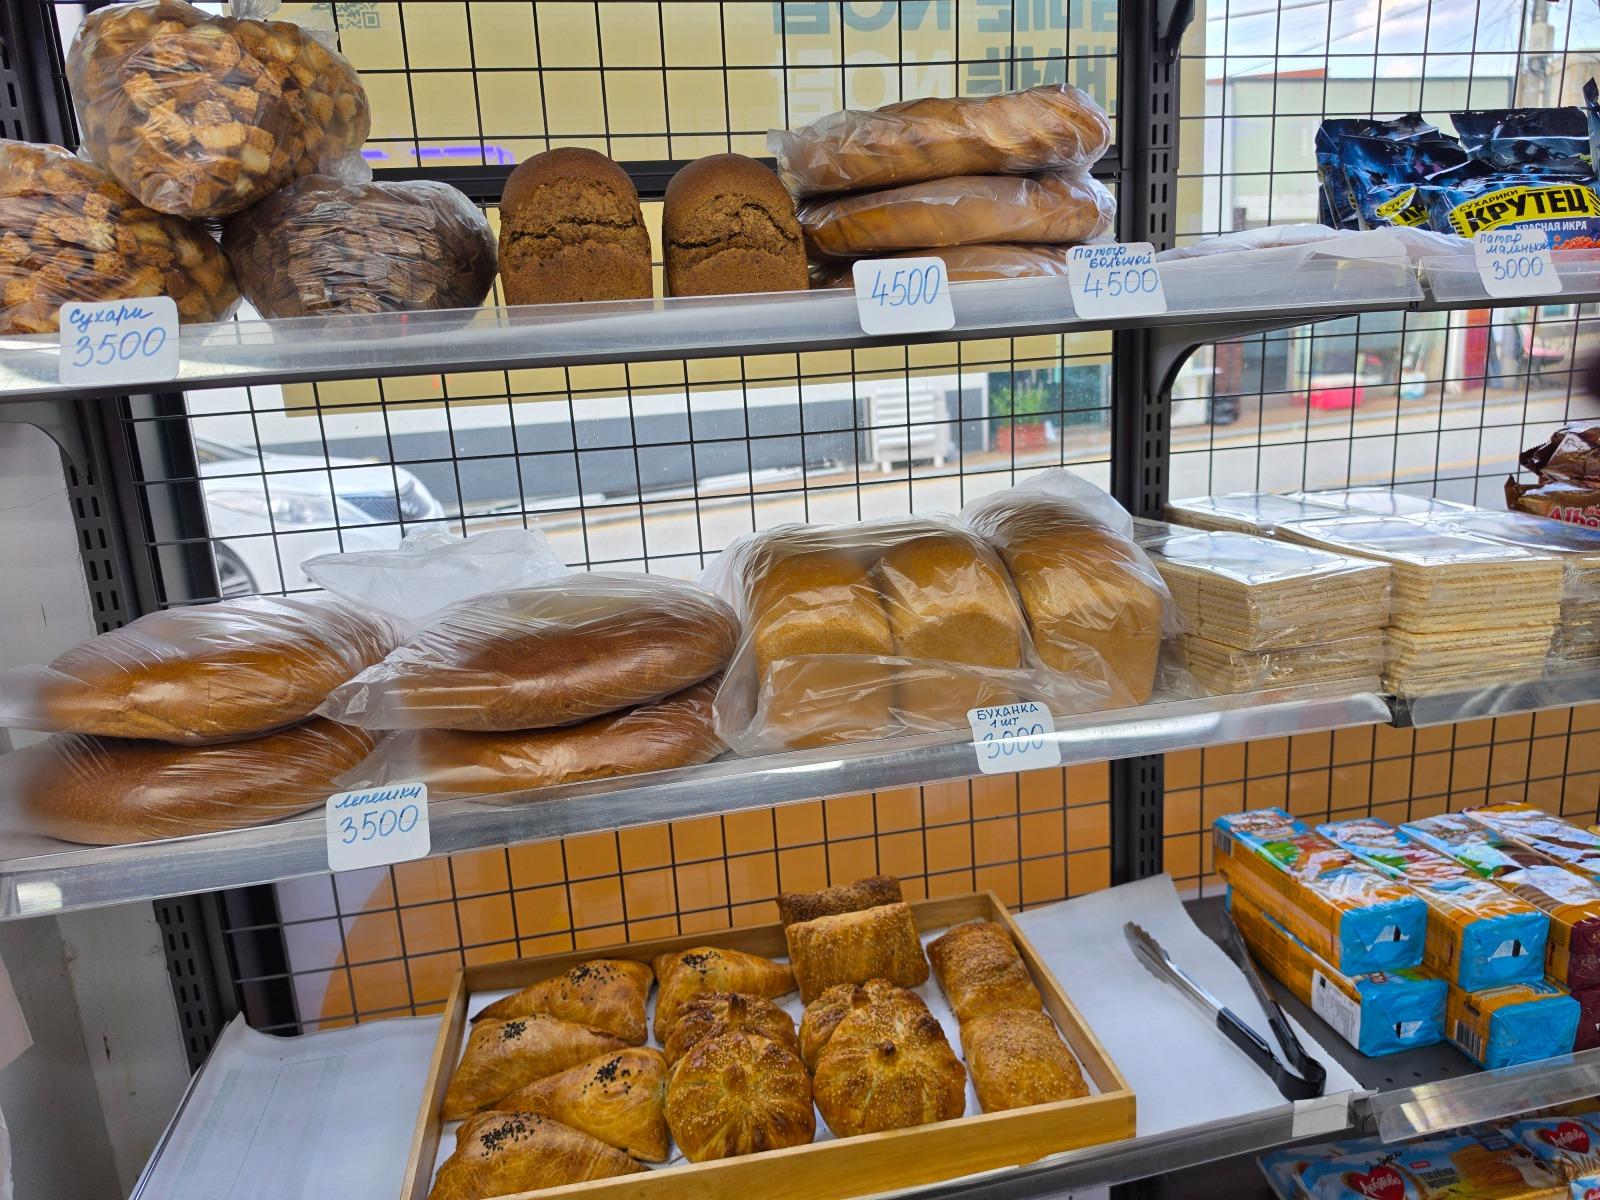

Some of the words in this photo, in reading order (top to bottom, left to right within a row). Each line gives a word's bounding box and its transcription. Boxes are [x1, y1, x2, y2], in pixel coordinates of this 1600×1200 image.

[1459, 189, 1519, 212] СУХАРИКИ
[1463, 187, 1589, 234] КРУТЕЦ
[1562, 220, 1588, 231] ИКРА
[1084, 268, 1158, 297] 4500
[1493, 256, 1543, 280] 3000
[872, 265, 941, 306] 4500
[72, 327, 166, 367] 3500
[976, 703, 1039, 720] БУХАНКА
[990, 719, 997, 728] 1
[983, 724, 1044, 759] 3000
[340, 804, 419, 844] 3500
